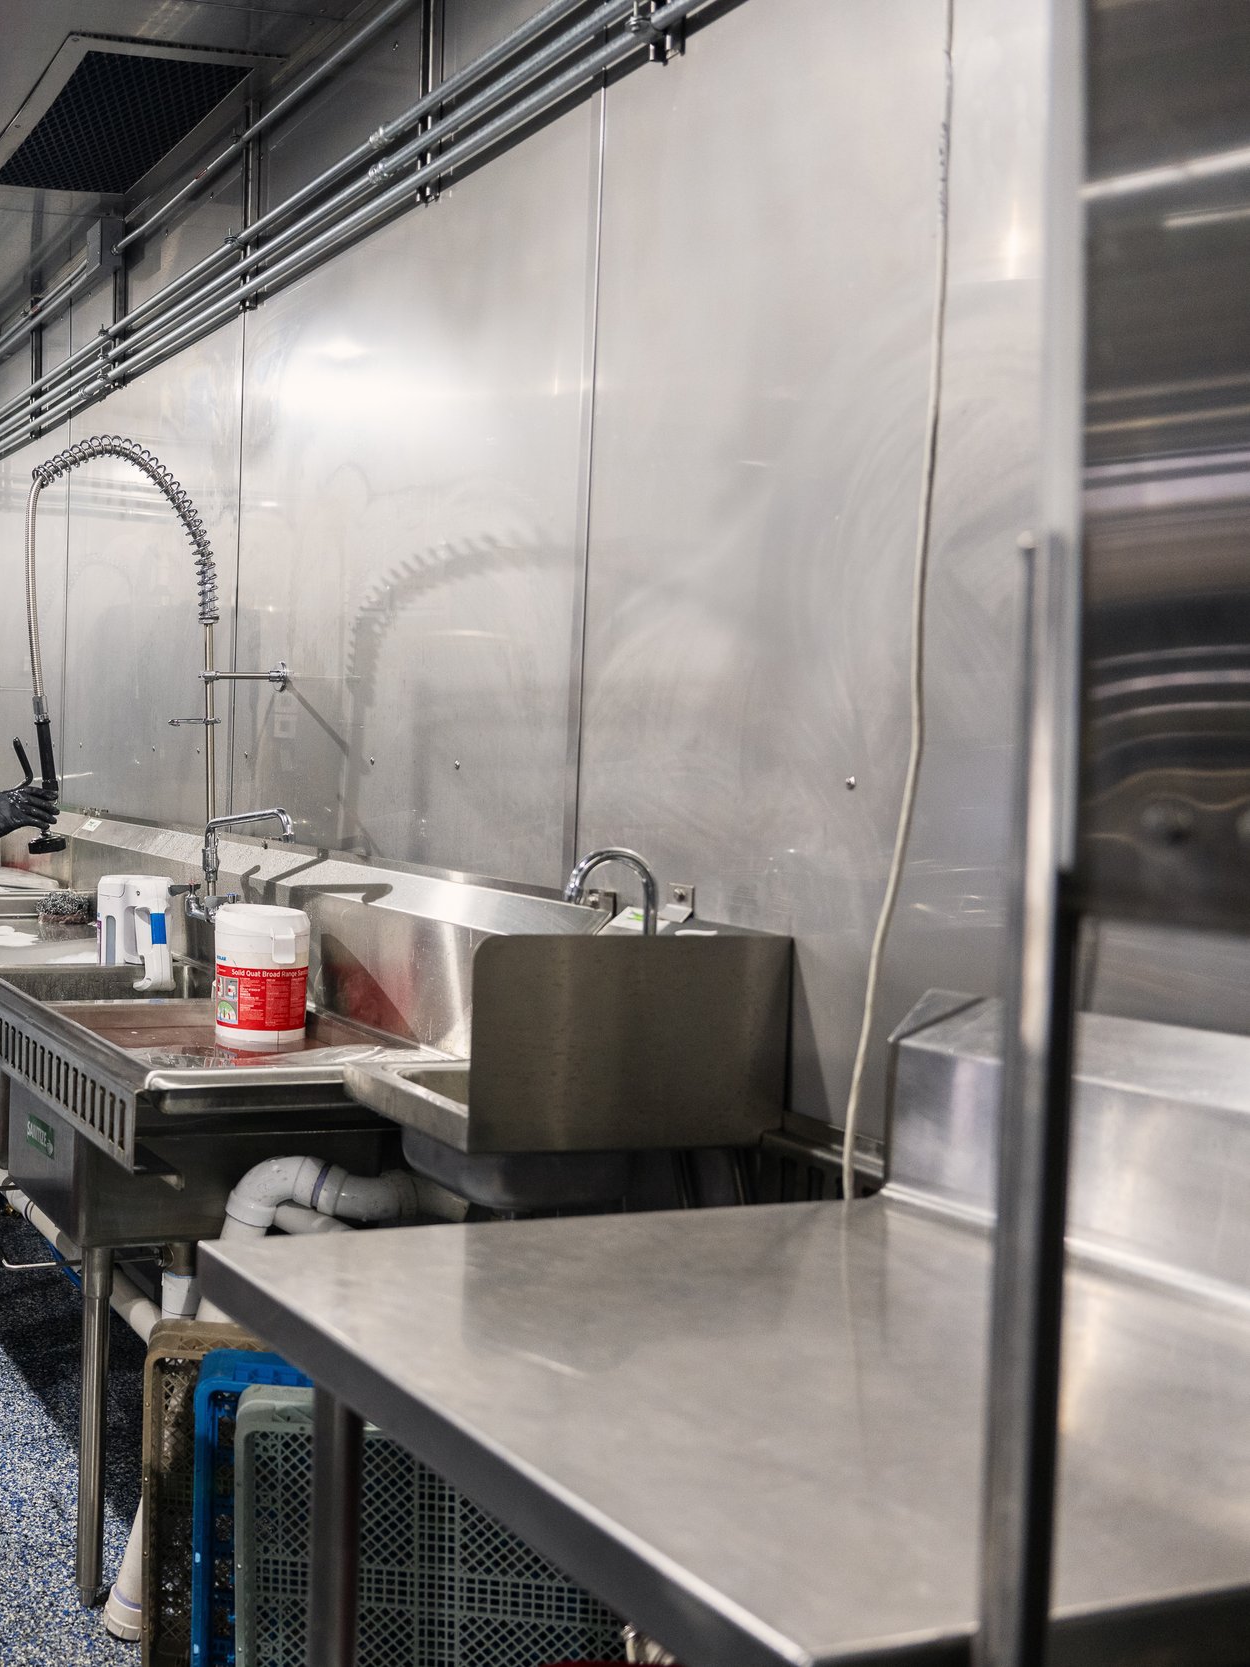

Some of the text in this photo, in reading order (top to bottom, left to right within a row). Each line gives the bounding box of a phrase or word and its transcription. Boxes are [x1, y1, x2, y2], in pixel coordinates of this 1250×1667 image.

[231, 968, 245, 976] Solid
[281, 970, 298, 978] Range
[26, 1120, 46, 1146] SANITIZE
